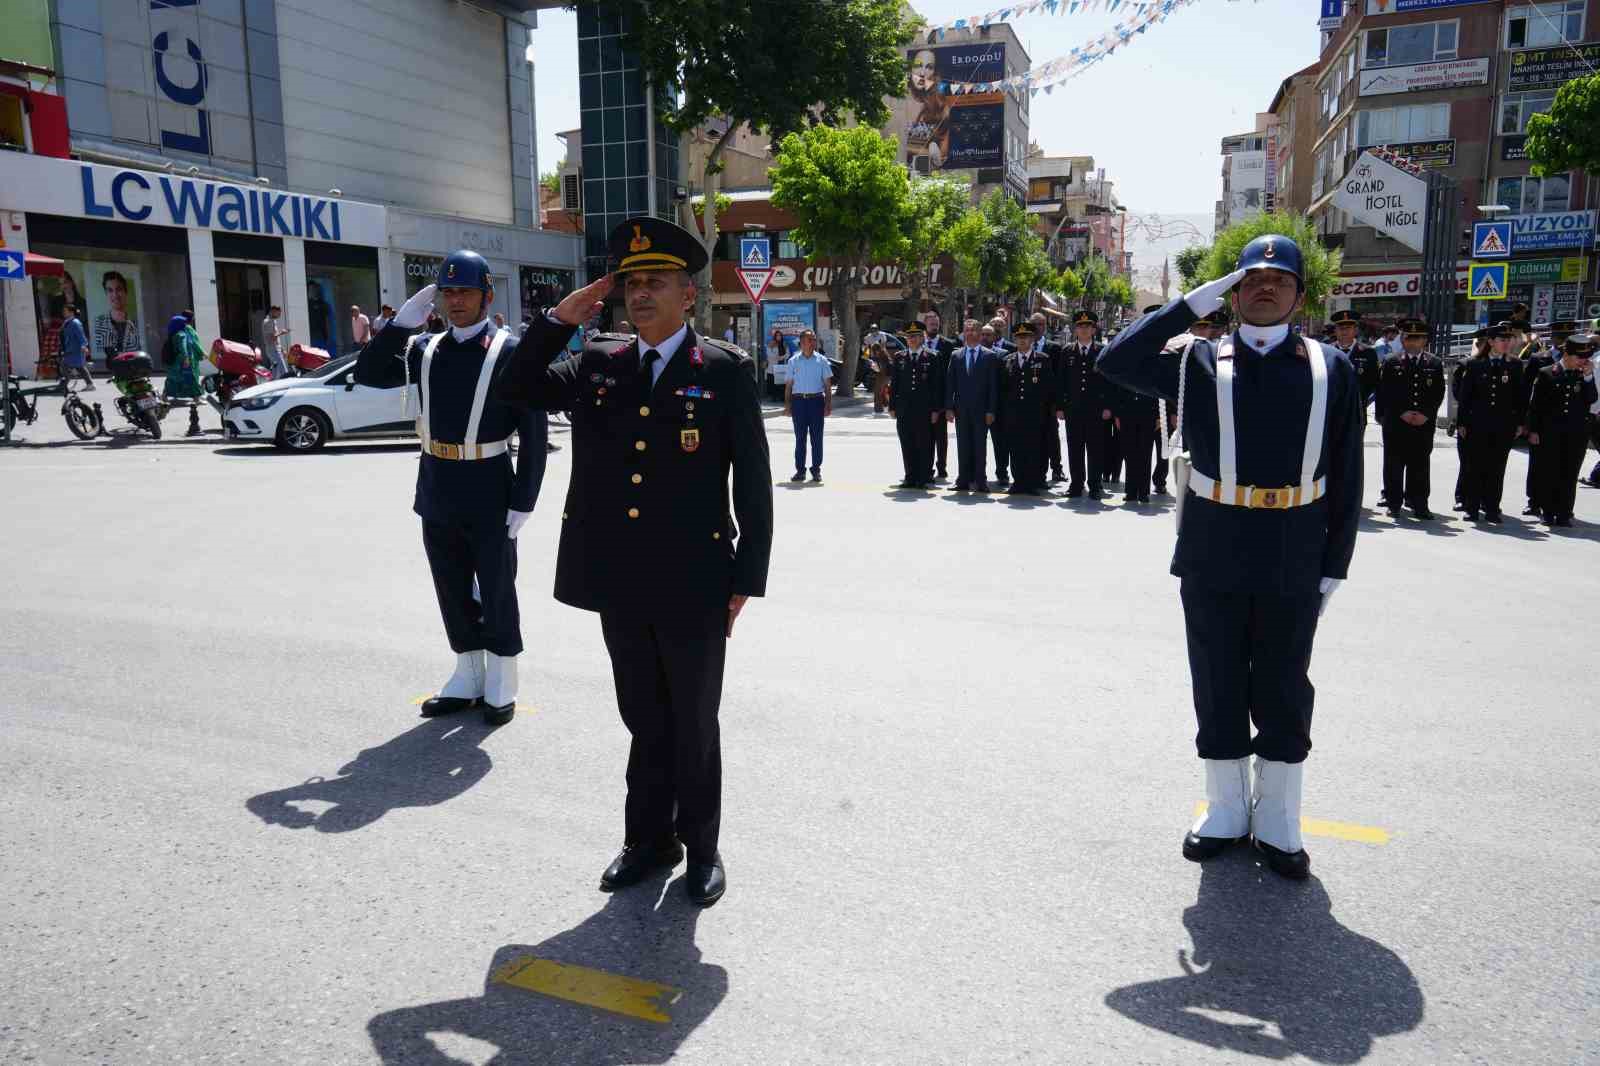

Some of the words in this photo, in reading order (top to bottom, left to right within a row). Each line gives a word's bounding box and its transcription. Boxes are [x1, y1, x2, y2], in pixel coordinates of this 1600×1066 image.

[153, 30, 211, 155] LC
[81, 165, 153, 221] LC
[1346, 179, 1385, 195] GRAND
[1366, 194, 1404, 211] HOTEL
[1516, 213, 1590, 233] VİZYON
